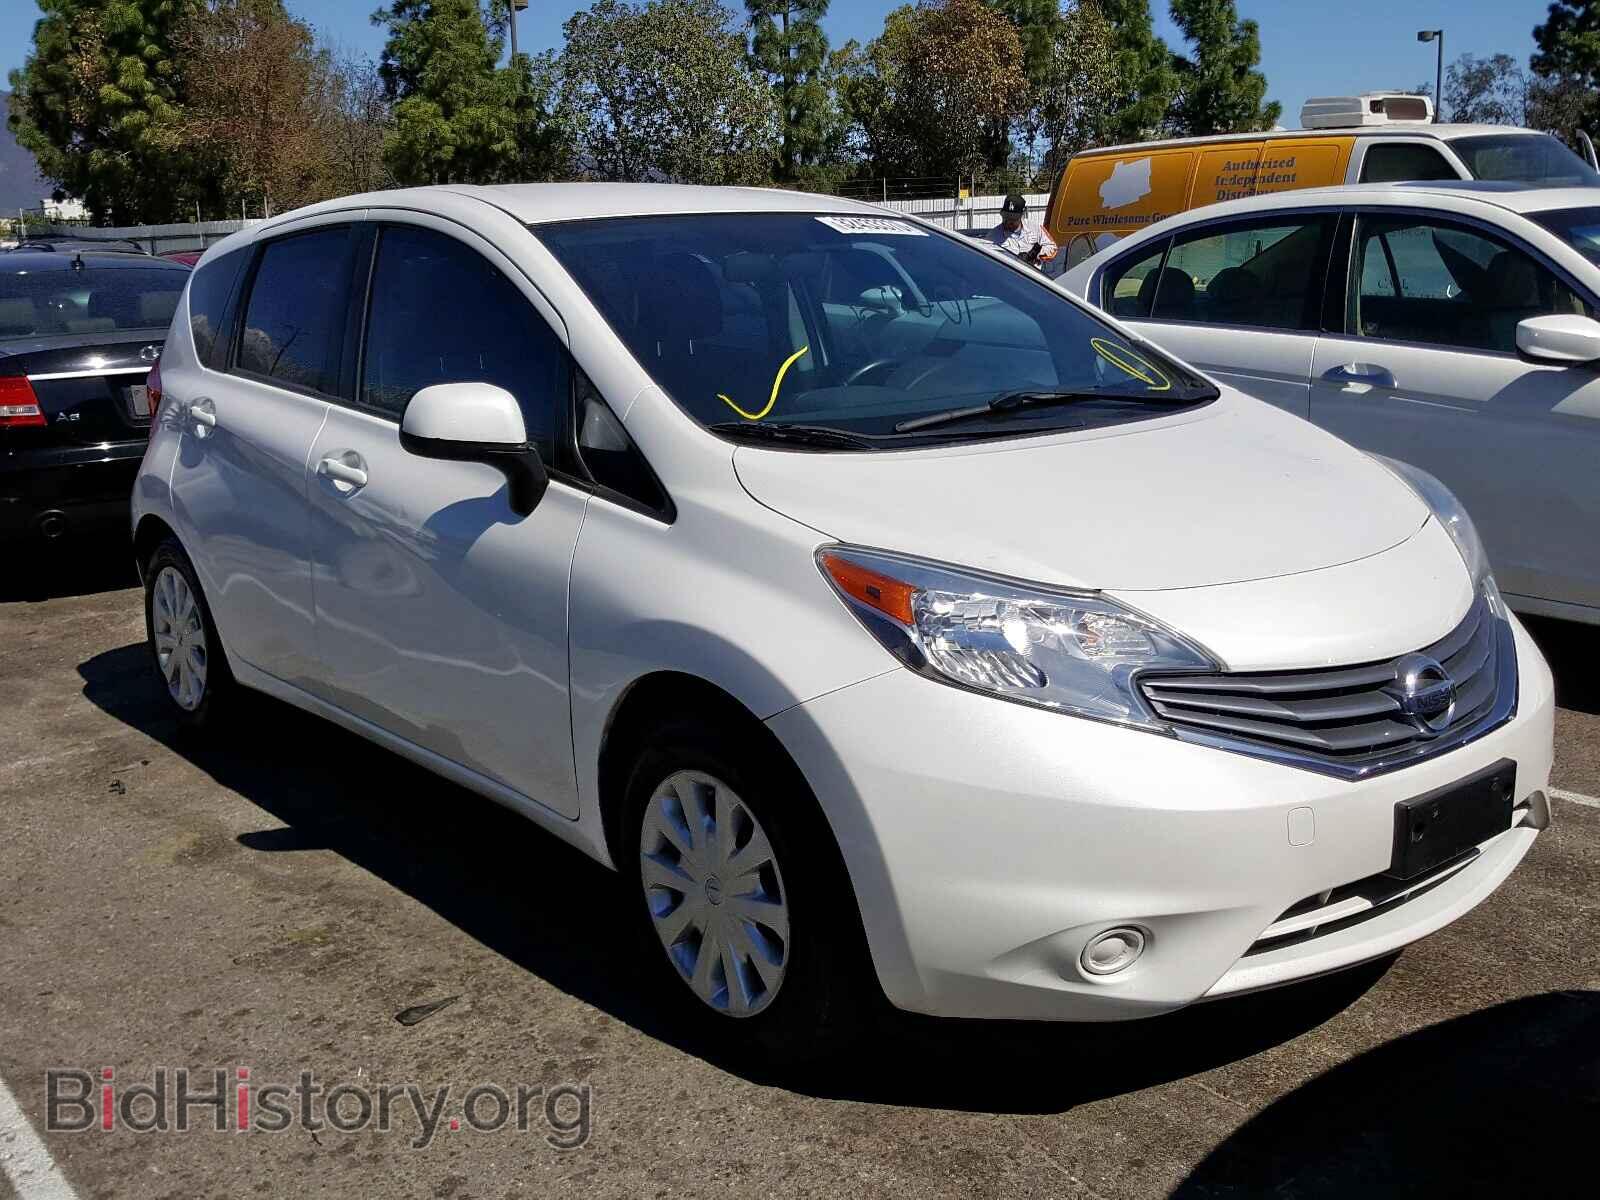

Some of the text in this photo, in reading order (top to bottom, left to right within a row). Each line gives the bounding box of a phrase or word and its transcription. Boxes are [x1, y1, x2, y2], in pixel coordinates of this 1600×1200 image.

[1223, 156, 1297, 171] Authorized
[1216, 172, 1297, 187] Independent
[1067, 216, 1090, 226] Pure
[1092, 214, 1151, 225] Wholesome
